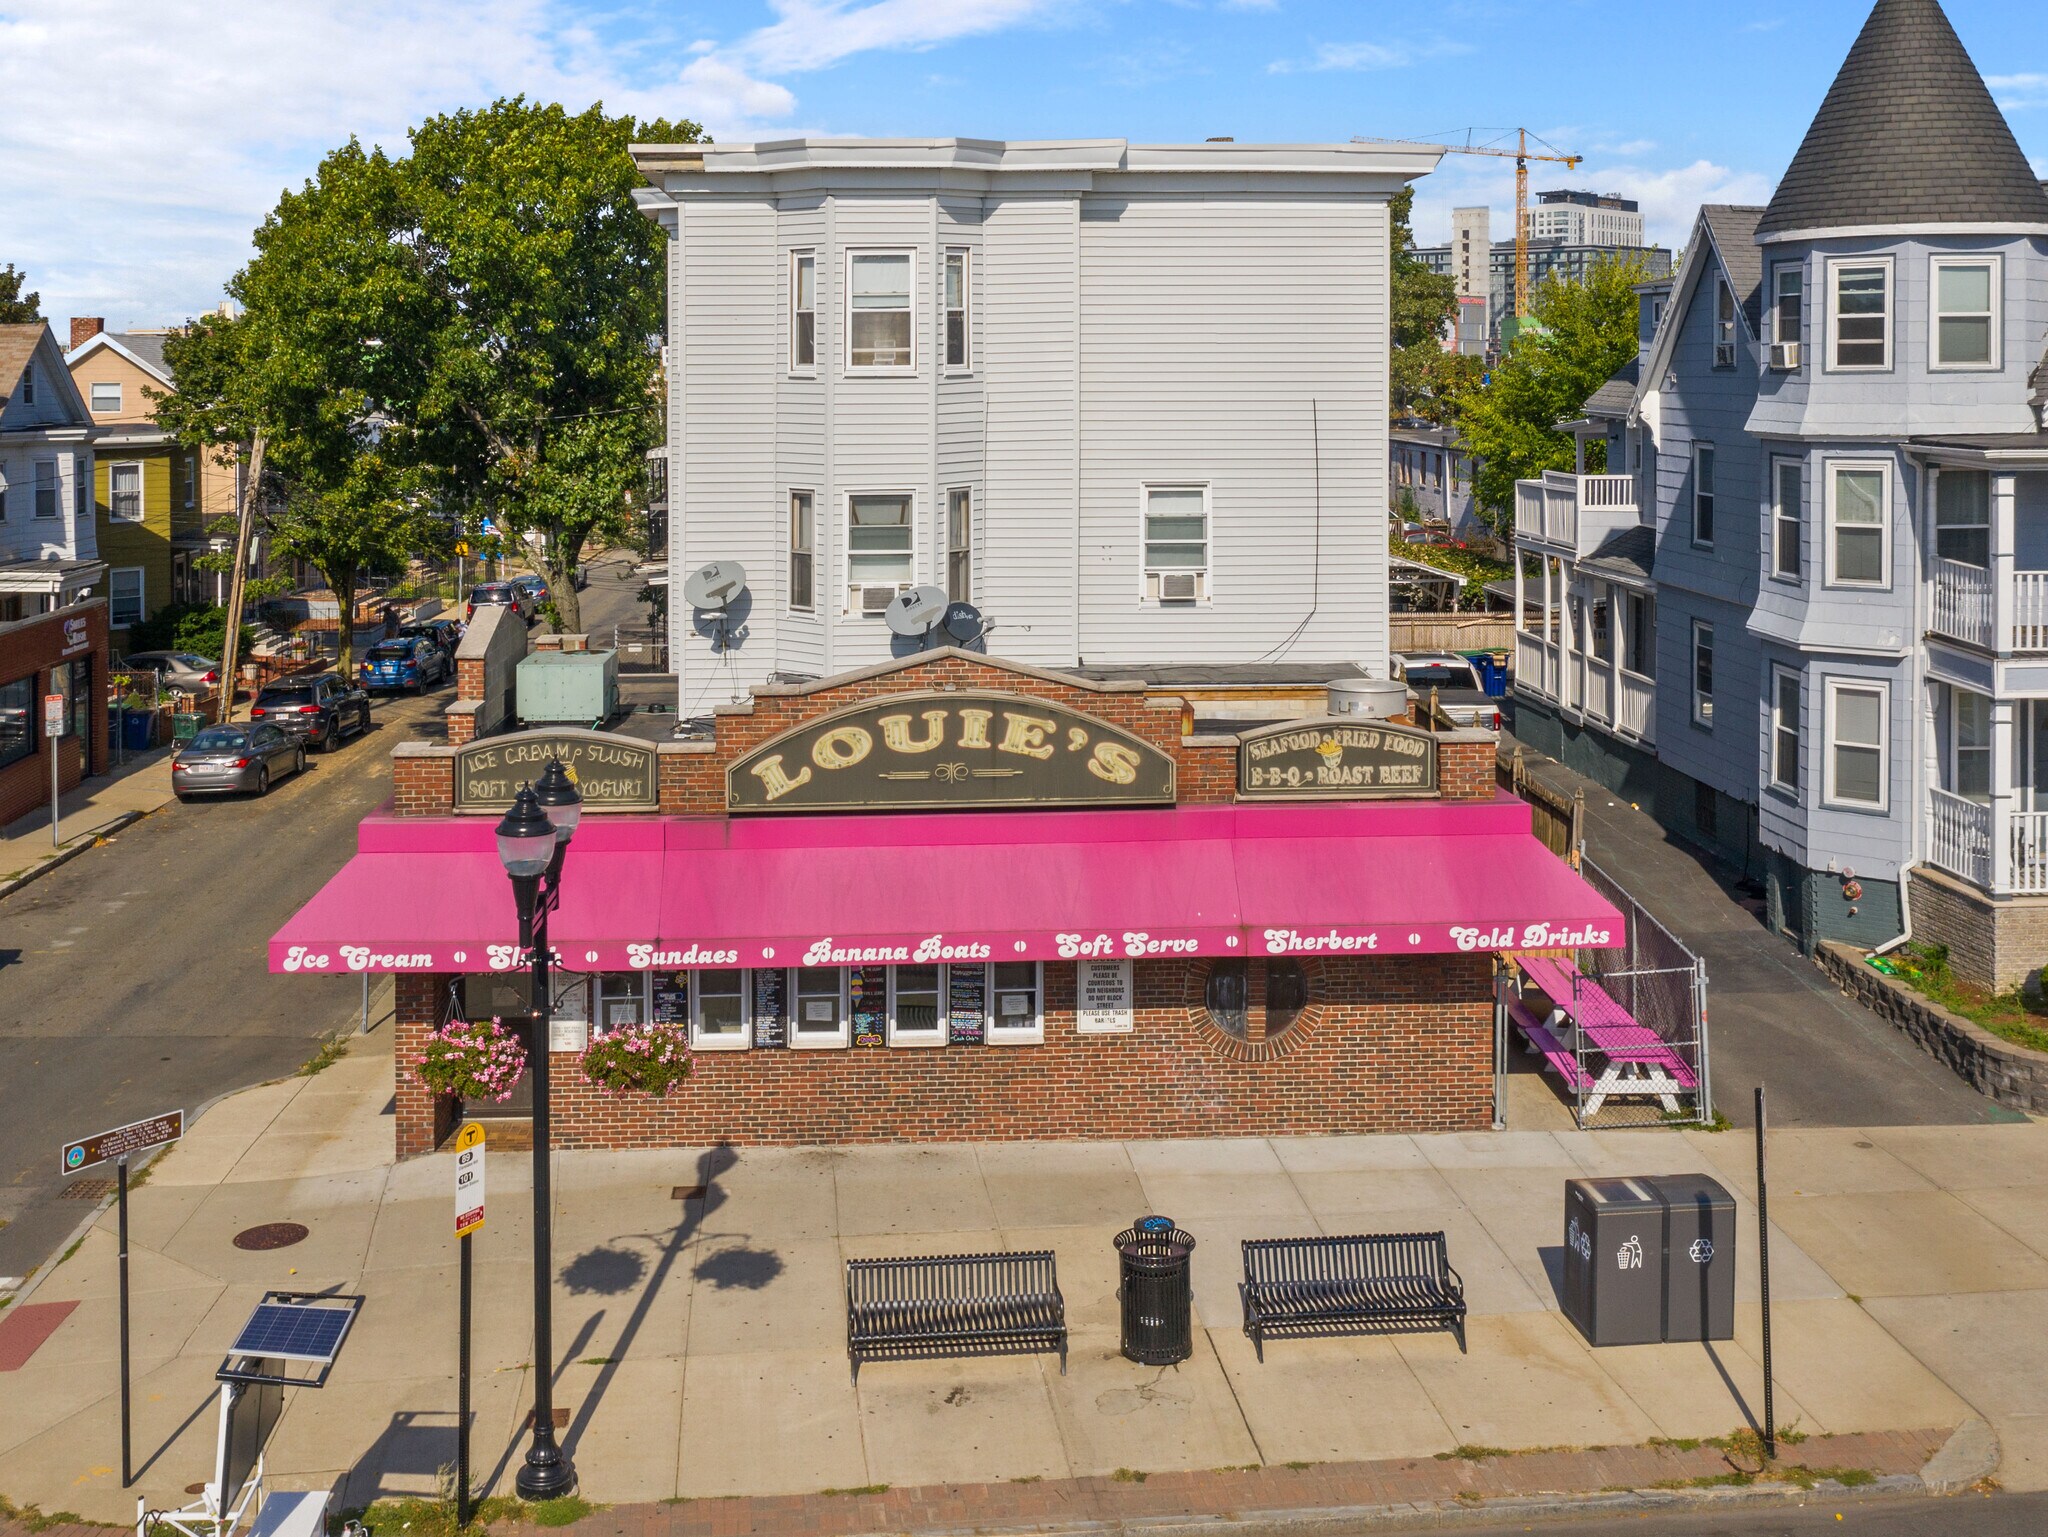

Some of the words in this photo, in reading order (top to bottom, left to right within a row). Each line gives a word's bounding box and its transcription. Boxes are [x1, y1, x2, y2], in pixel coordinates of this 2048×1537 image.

[751, 709, 1141, 801] LOUIE'S
[1251, 731, 1322, 760] SEAFOOD
[1333, 729, 1380, 749] FRIED
[1384, 736, 1425, 758] FOOD
[468, 752, 497, 773] ICE
[505, 744, 570, 765] CREAM
[588, 746, 644, 769] SLUSH
[1317, 766, 1374, 785] ROAST
[1379, 765, 1424, 784] BEEF
[469, 780, 507, 798] SOFT
[581, 780, 643, 798] YOGURT
[283, 946, 329, 972] Ice
[339, 945, 433, 971] Cream
[486, 945, 564, 970] Slh
[626, 943, 738, 968] Sundaes
[802, 937, 909, 967] Banana
[912, 934, 991, 963] Boats
[1055, 933, 1113, 958] Soft
[1122, 932, 1199, 957] Serve
[1263, 929, 1378, 954] Sherbert
[1449, 926, 1514, 951] Cold
[1520, 922, 1610, 948] Drinks
[466, 1130, 475, 1143] T
[460, 1172, 473, 1183] 101
